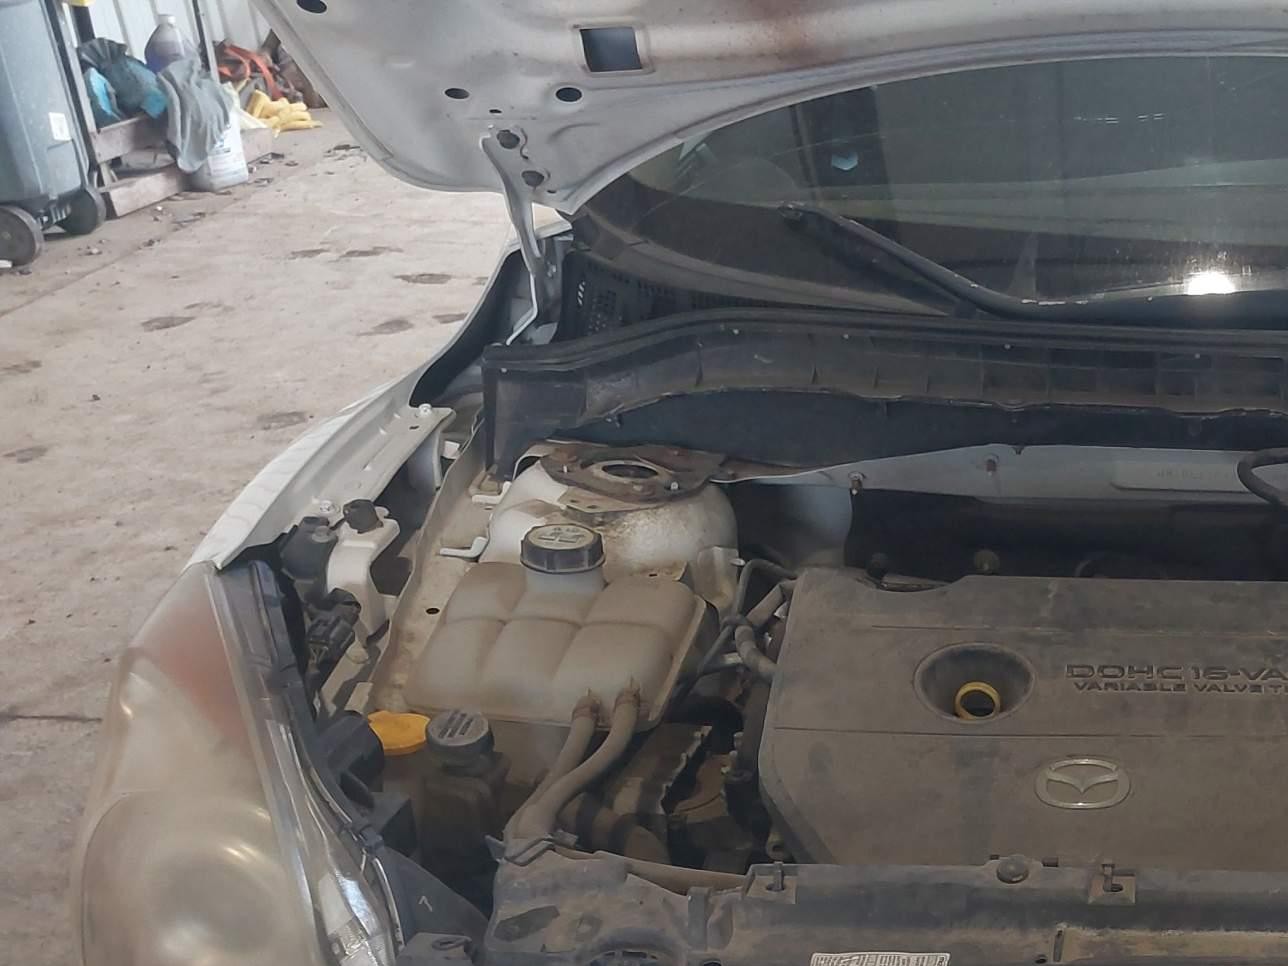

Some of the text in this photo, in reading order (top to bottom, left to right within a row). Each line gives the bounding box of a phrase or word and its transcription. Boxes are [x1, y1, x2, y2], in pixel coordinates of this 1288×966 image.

[1065, 664, 1183, 679] DOHC
[1074, 682, 1186, 692] VARIABLE
[1194, 684, 1263, 693] VALVE
